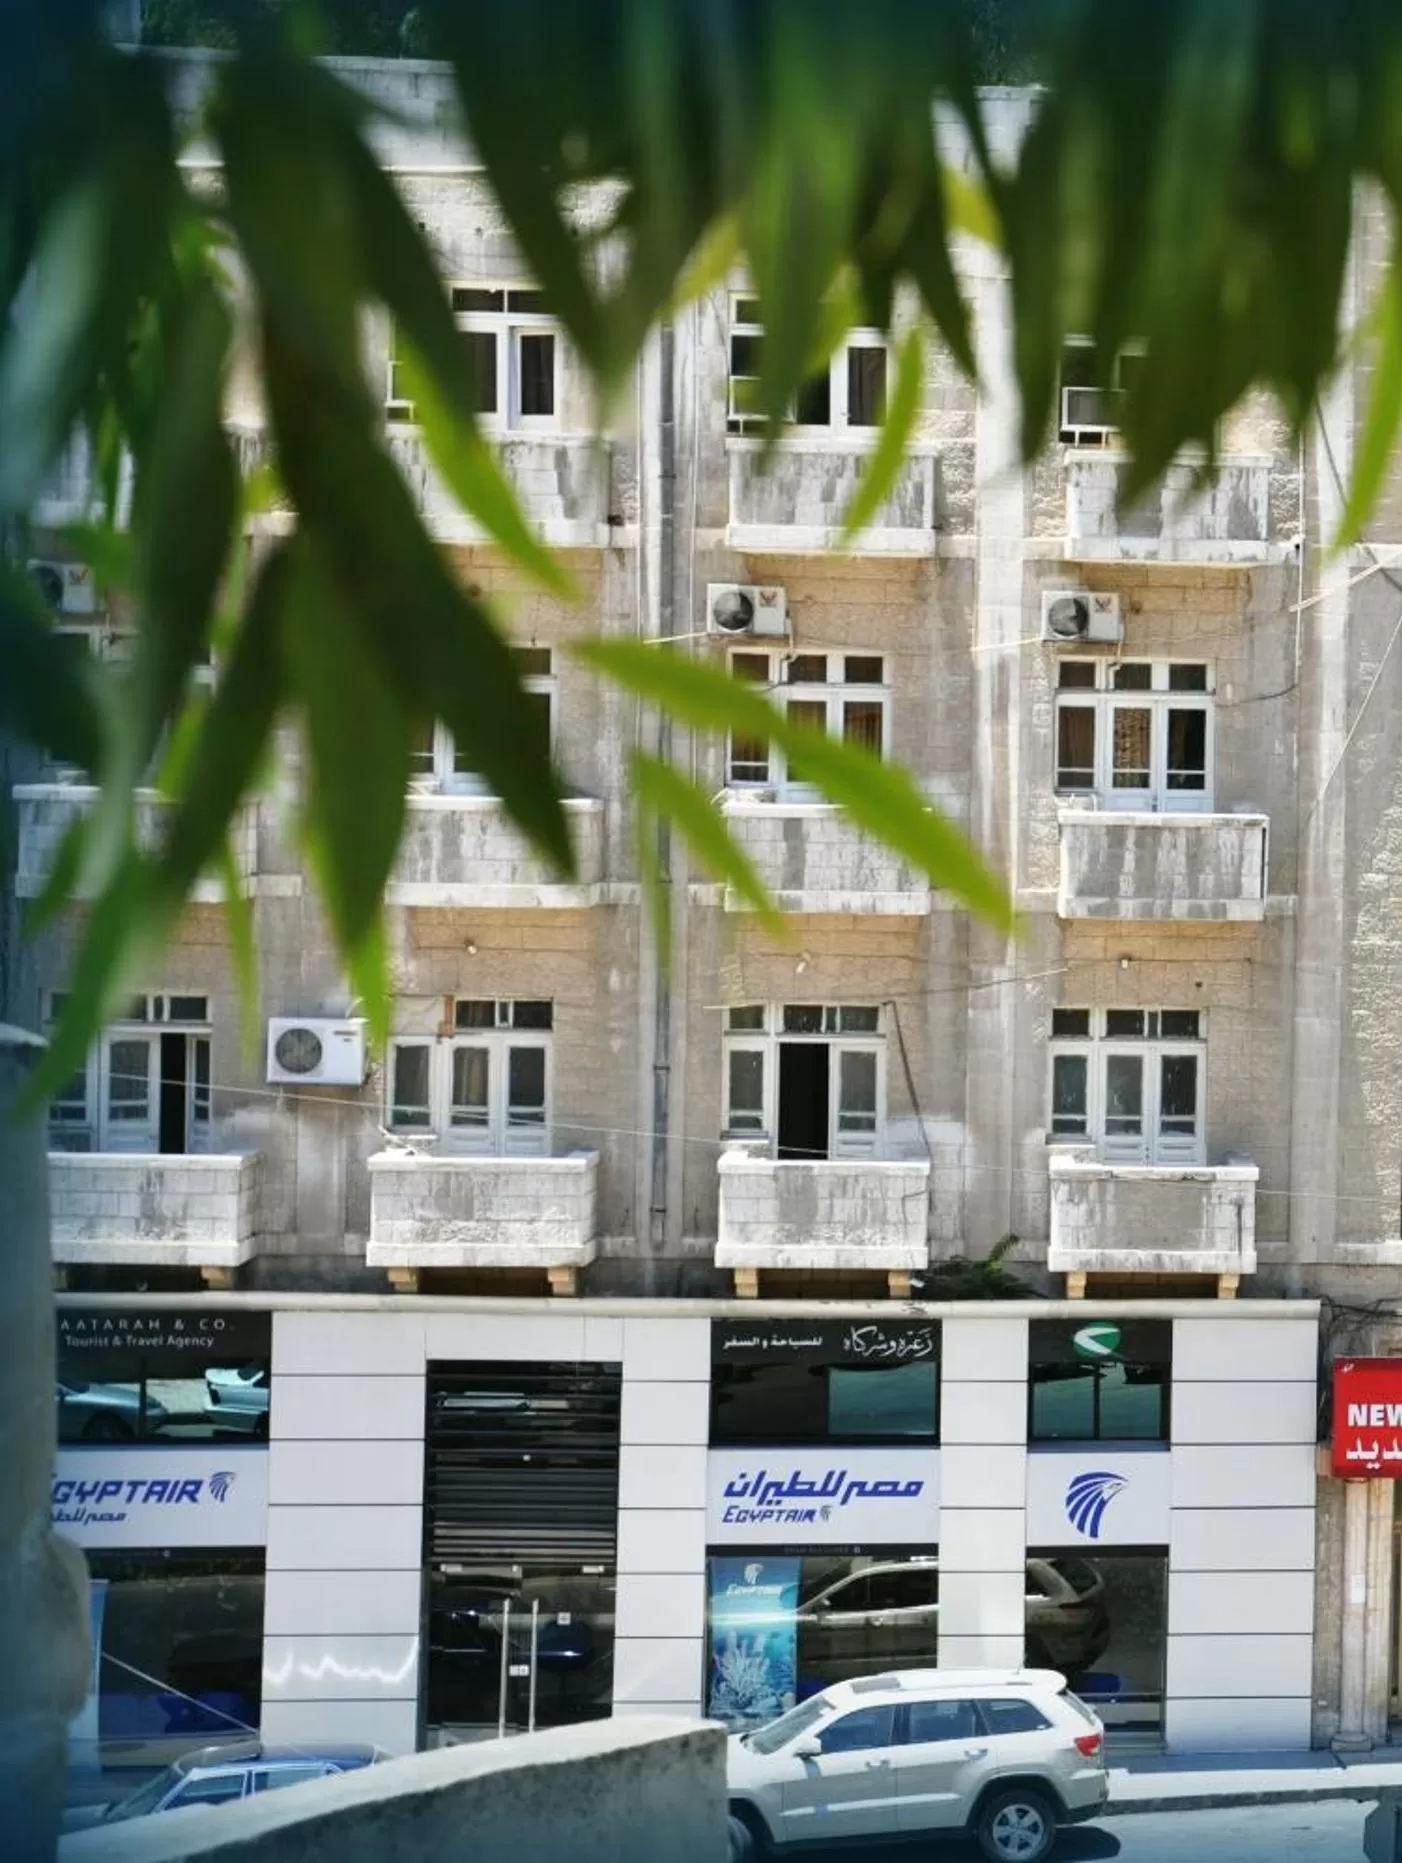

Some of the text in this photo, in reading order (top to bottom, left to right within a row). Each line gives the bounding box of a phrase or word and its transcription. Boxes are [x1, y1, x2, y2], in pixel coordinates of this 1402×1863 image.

[59, 1318, 161, 1331] AATARAH
[125, 1335, 164, 1348] Travel
[166, 1335, 215, 1350] Agency
[722, 1334, 760, 1350] السفر
[771, 1335, 823, 1350] للسياحة
[50, 1472, 204, 1505] GYPTAIR
[722, 1469, 925, 1506] مصر للطيران
[721, 1504, 818, 1524] EGYPTAIR
